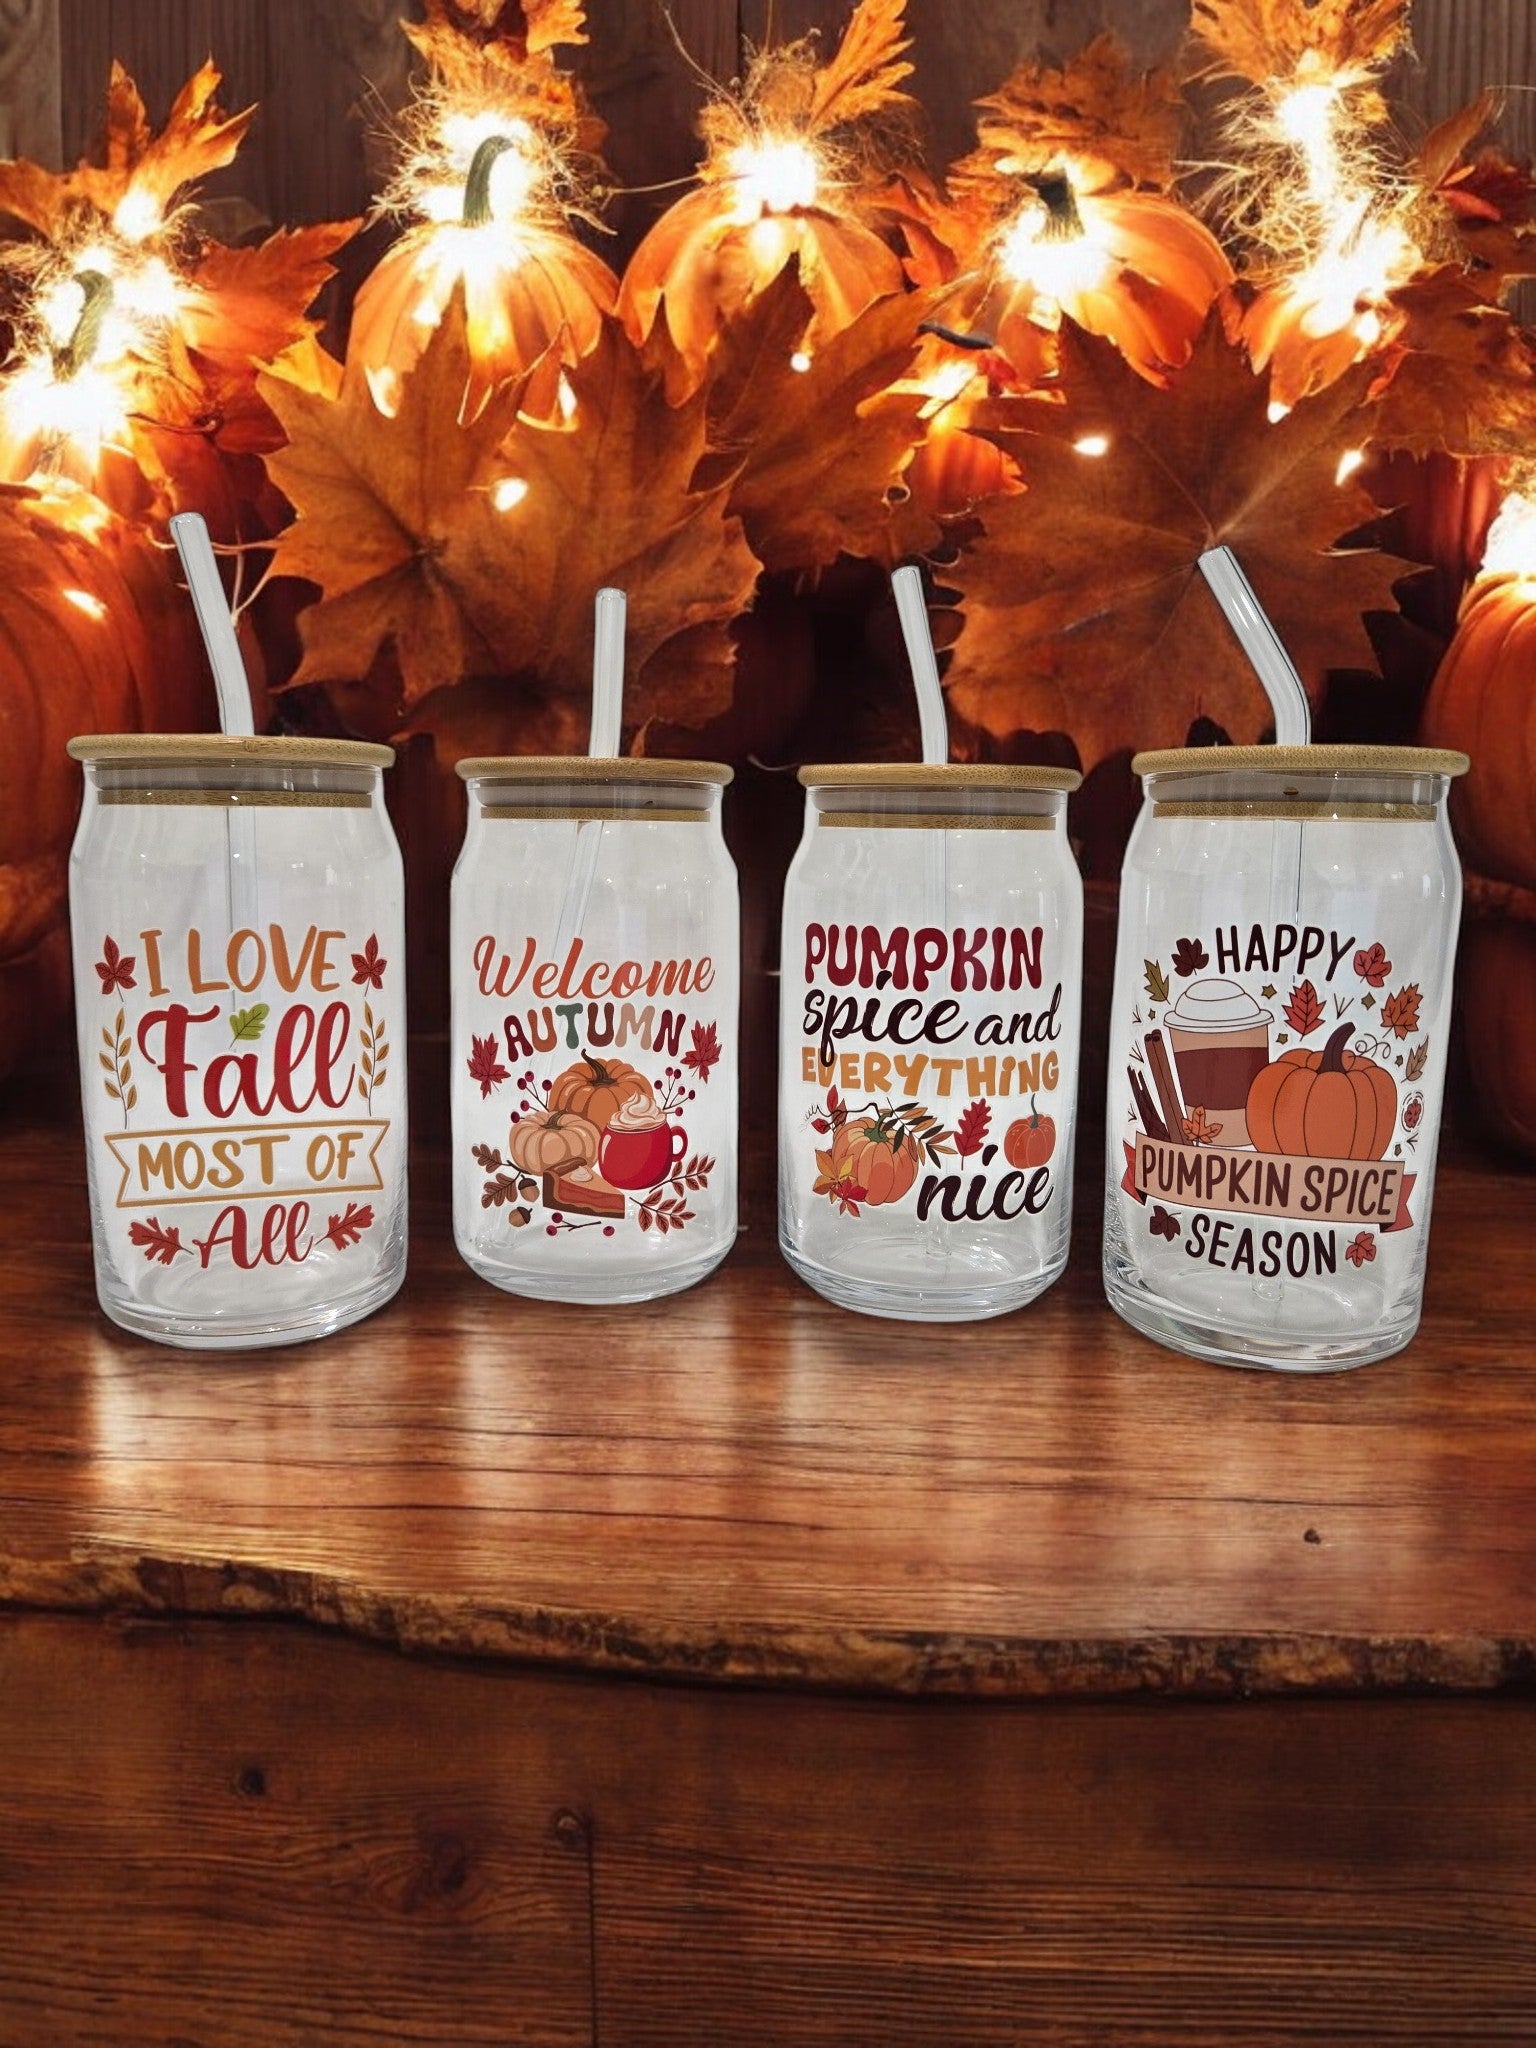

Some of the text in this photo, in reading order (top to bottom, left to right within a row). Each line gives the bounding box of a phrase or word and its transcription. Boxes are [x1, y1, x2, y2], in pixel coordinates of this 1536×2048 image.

[140, 924, 346, 997] I LOVE
[474, 935, 715, 999] Welcome
[805, 923, 1043, 992] PUMPKIN
[1215, 924, 1356, 981] HAPPY
[503, 1002, 687, 1062] AUTUMN
[803, 970, 1062, 1067] spice and
[137, 1001, 355, 1118] Fall
[138, 1132, 364, 1191] MOST OF
[916, 1144, 1054, 1222] nice
[1142, 1144, 1397, 1216] PUMPKIN SPICE
[192, 1201, 313, 1269] All
[1185, 1213, 1337, 1278] SEASON
